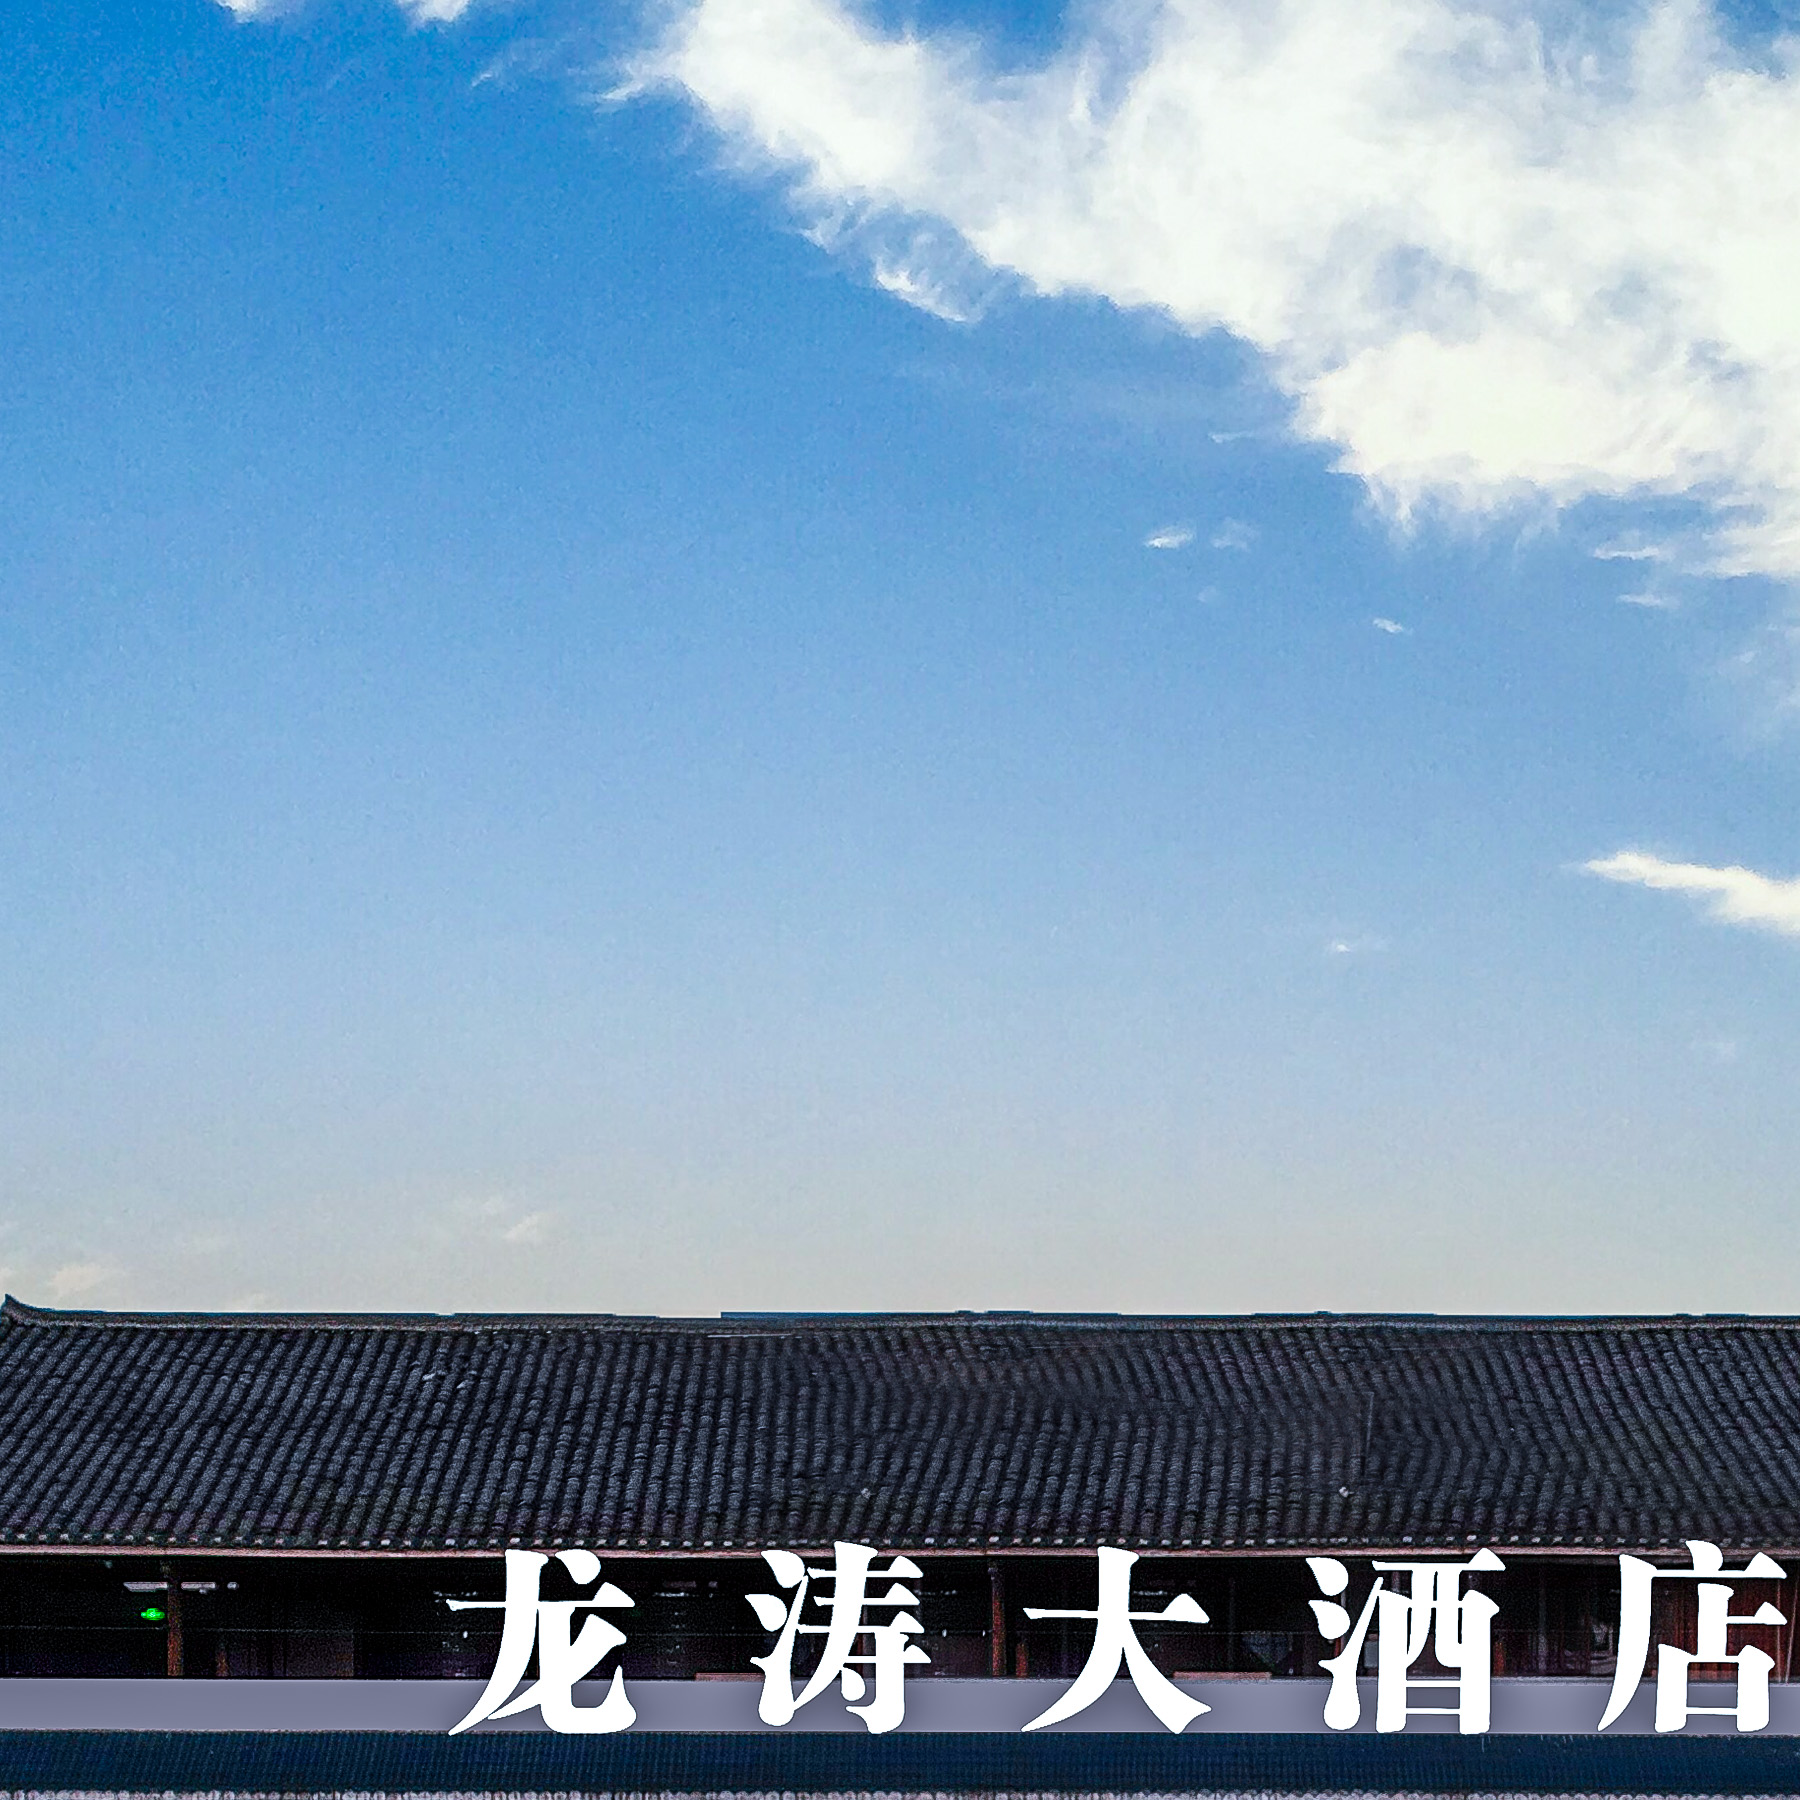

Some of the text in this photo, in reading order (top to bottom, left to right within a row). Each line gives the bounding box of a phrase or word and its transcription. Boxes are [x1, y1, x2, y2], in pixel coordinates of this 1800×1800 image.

[447, 1540, 1788, 1736] 龙涛大酒店
